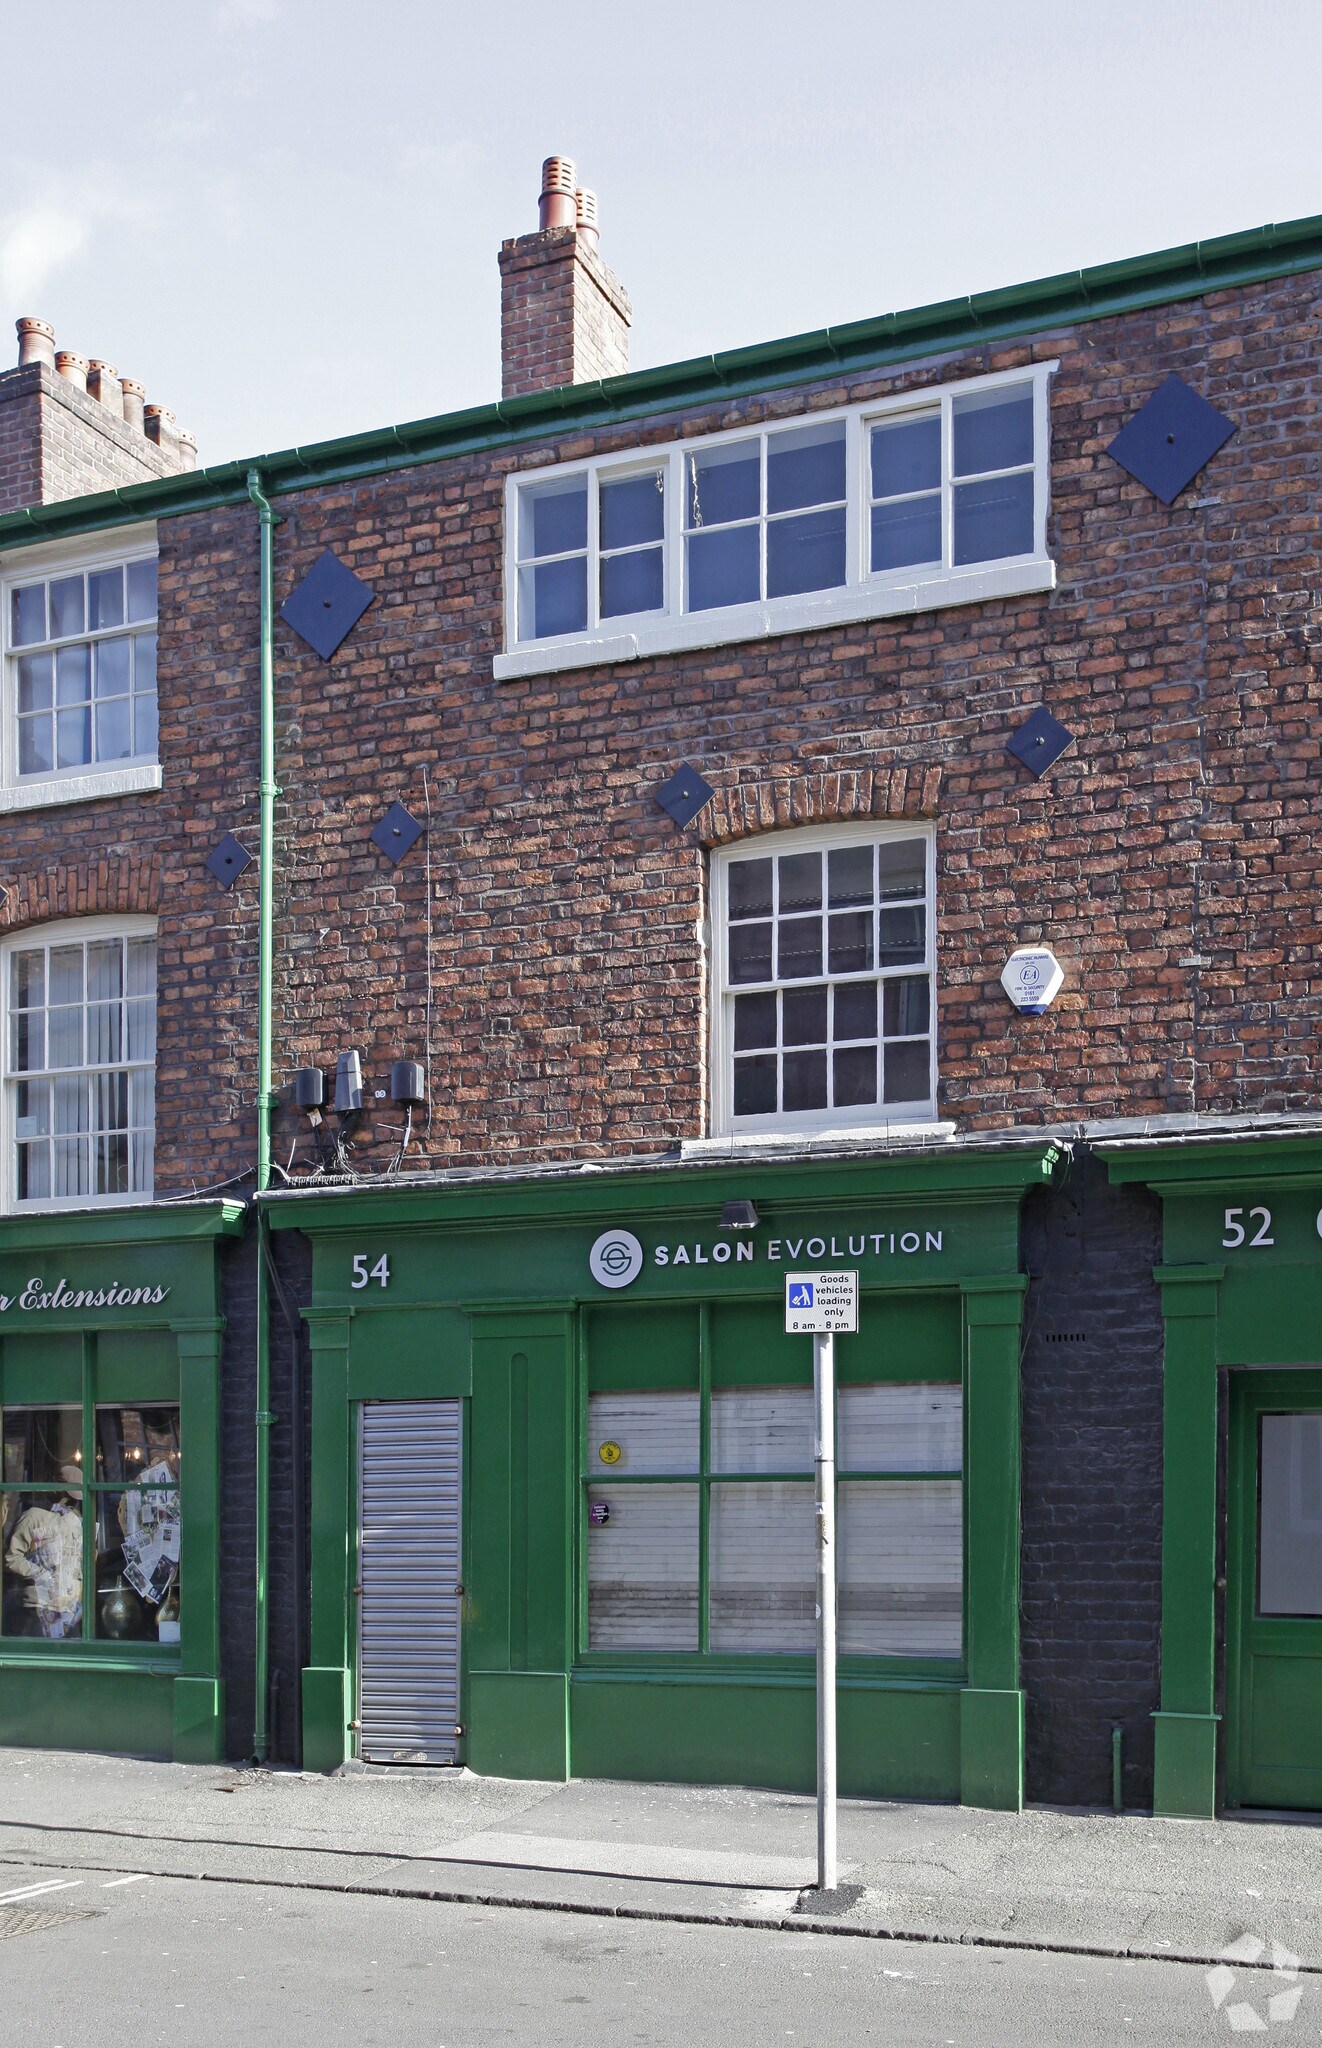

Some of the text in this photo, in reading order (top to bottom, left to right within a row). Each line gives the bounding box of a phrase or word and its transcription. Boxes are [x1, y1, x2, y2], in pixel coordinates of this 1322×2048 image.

[1023, 970, 1036, 980] EA
[1222, 1206, 1275, 1248] 52
[655, 1230, 943, 1266] SALON EVOLUTION
[351, 1253, 390, 1289] 54
[820, 1275, 849, 1283] Goods
[19, 1277, 171, 1310] Extensions
[815, 1286, 853, 1294] vehicles
[817, 1297, 851, 1306] loading
[824, 1308, 844, 1317] only
[792, 1321, 799, 1330] 8
[825, 1321, 832, 1329] 8
[835, 1322, 849, 1330] pm
